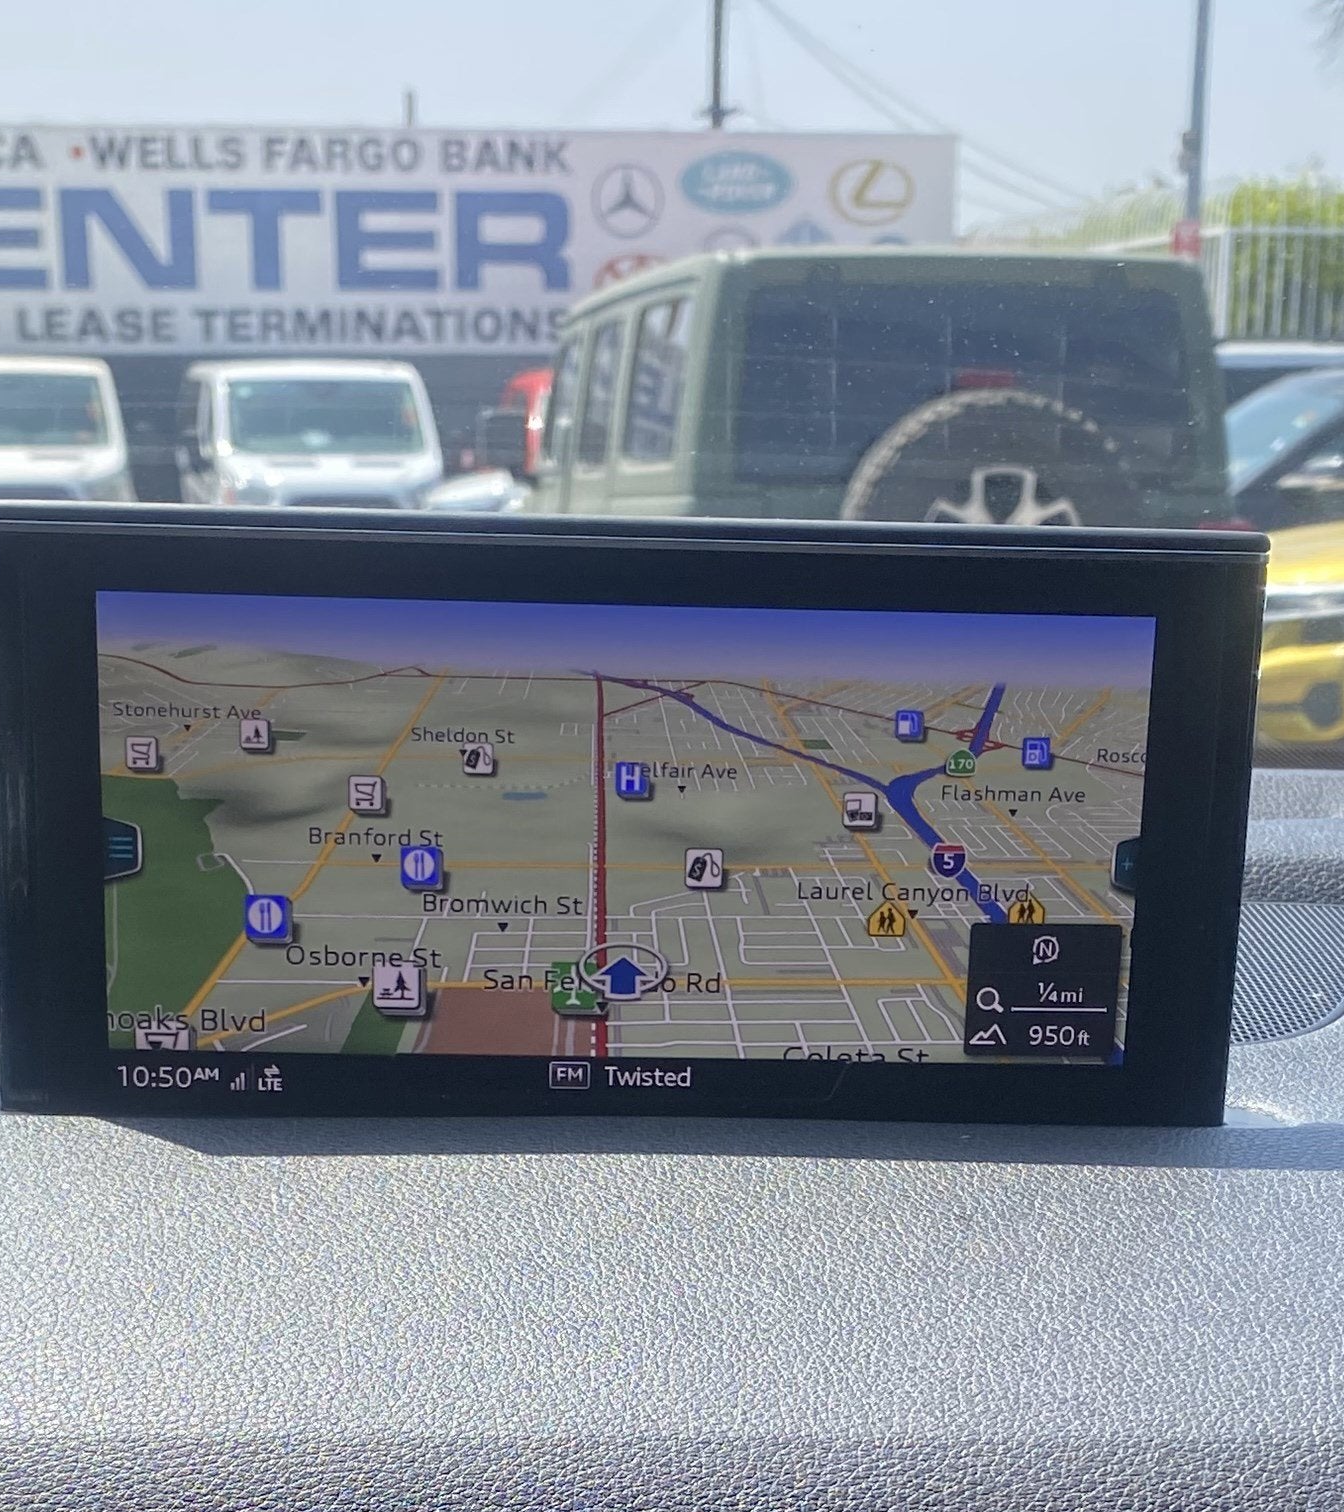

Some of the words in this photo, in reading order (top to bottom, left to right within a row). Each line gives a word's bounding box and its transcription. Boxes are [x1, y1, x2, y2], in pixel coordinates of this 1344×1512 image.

[89, 136, 246, 171] WELLS
[262, 137, 422, 173] FARGO
[440, 139, 570, 174] BANK
[16, 308, 175, 344] LEASE
[113, 702, 222, 719] Stonehurst
[226, 704, 262, 719] Ave
[411, 727, 488, 743] Sheldon
[495, 729, 516, 744] St
[701, 764, 738, 779] Ave
[949, 760, 974, 770] 170
[942, 785, 1042, 802] Flashman
[1048, 786, 1086, 803] Ave
[309, 828, 411, 846] Branford
[420, 830, 443, 847] St
[943, 854, 955, 870] 5
[423, 893, 547, 914] Bromwich
[557, 896, 583, 915] St
[798, 882, 873, 900] Laurel
[882, 882, 970, 907] Canyon
[979, 883, 1033, 903] Blvd
[286, 945, 403, 967] Osborne
[412, 948, 442, 968] St
[484, 969, 533, 990] San
[687, 972, 721, 993] Rd
[200, 1008, 265, 1033] Blvd
[898, 1048, 929, 1063] St
[258, 1078, 283, 1091] LTE
[557, 1068, 583, 1082] FM
[605, 1066, 691, 1086] Twisted
